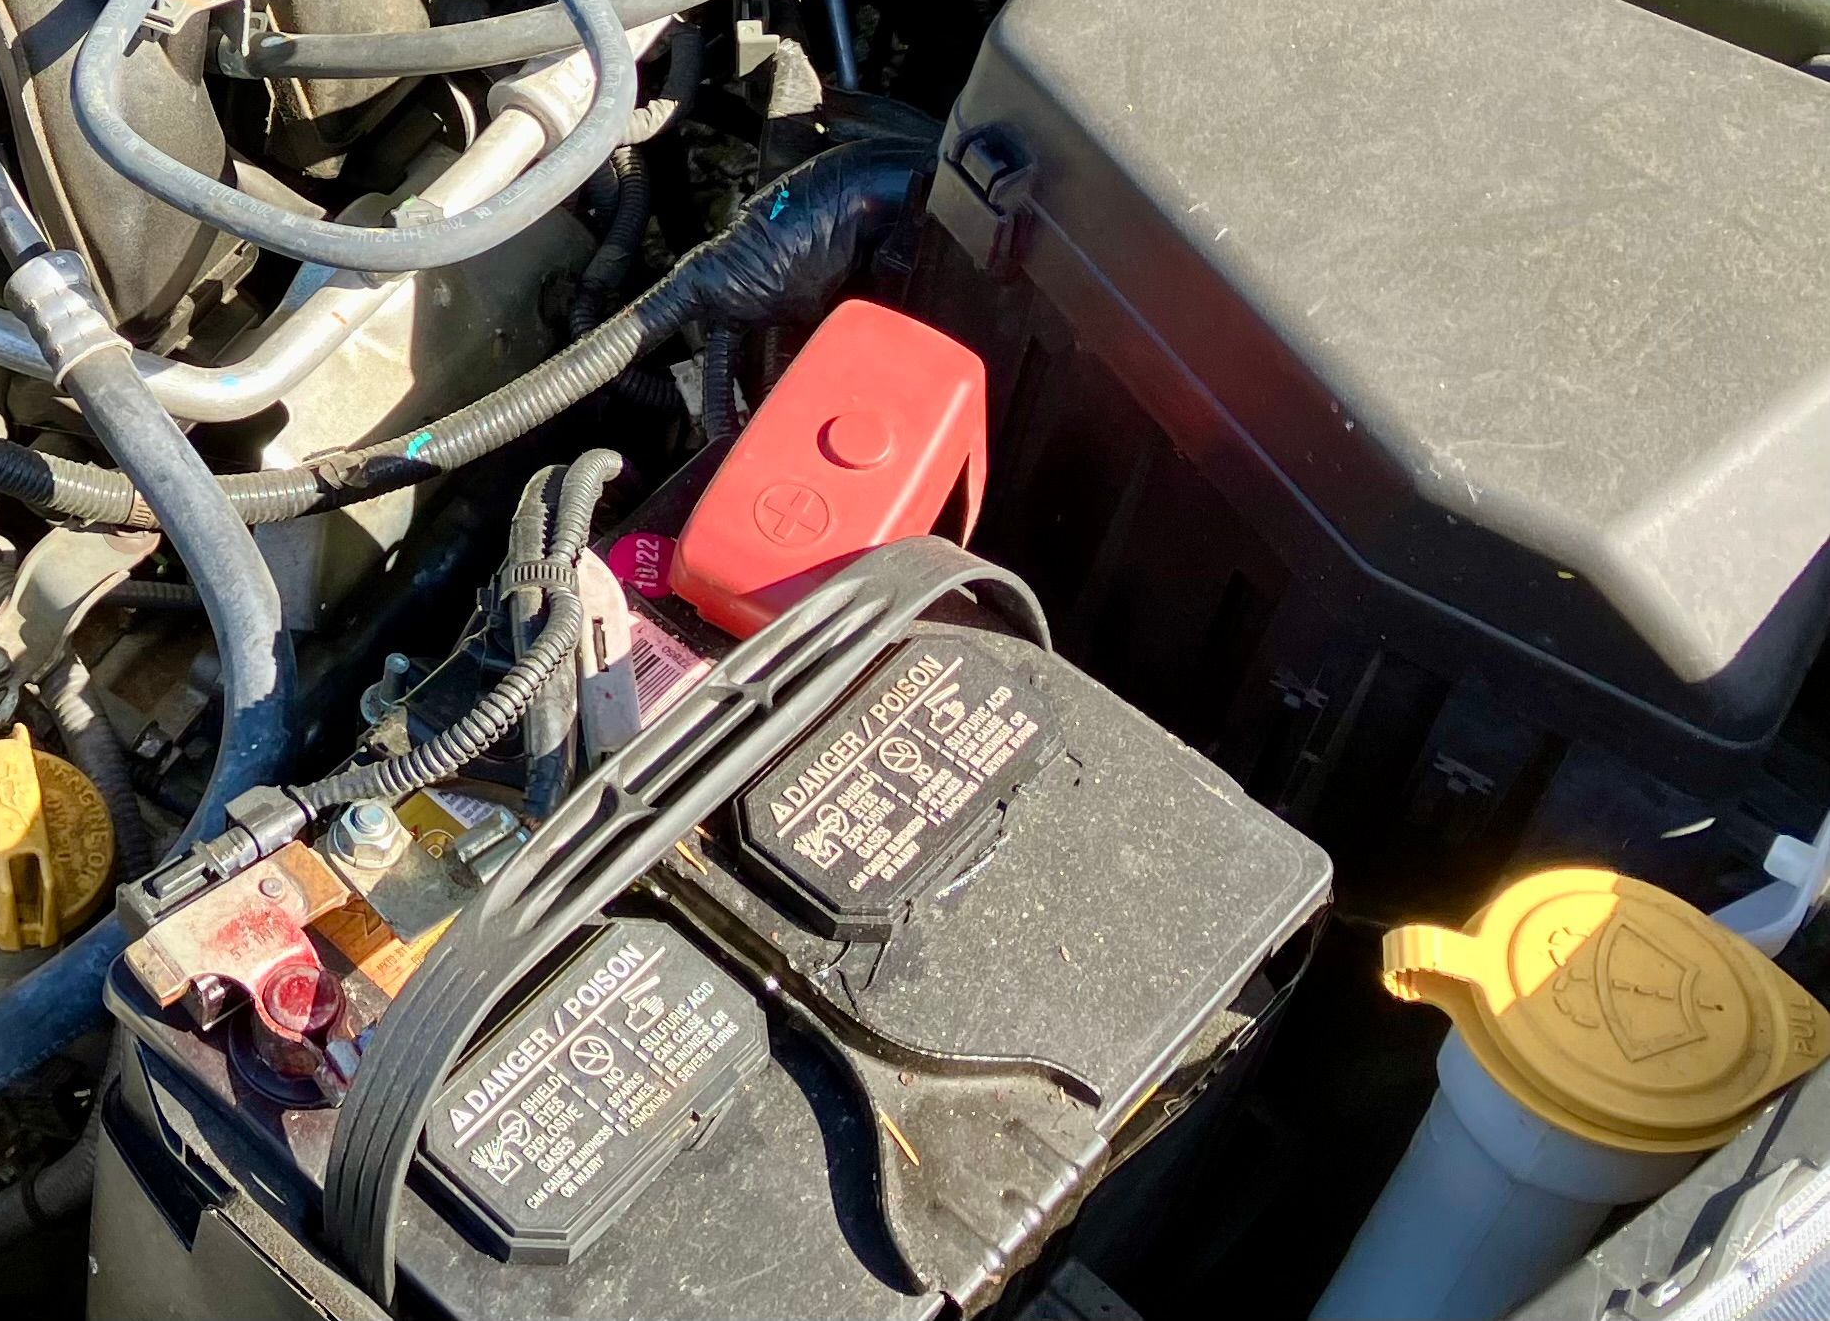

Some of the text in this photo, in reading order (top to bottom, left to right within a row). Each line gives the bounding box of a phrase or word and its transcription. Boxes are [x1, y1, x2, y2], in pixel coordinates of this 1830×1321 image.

[634, 540, 657, 587] 10/22
[782, 727, 865, 810] DANGER
[868, 651, 944, 727] POISON
[943, 684, 1013, 752] SULFURIC ACID
[835, 772, 875, 808] SHIELD
[910, 762, 935, 785] NO
[848, 790, 880, 819] EYES
[939, 780, 980, 817] SMOKING
[841, 797, 897, 850] EXPLOSIVE
[854, 825, 893, 860] GASES
[462, 1024, 558, 1115] DANGER
[561, 941, 646, 1021] POISON
[638, 979, 717, 1051] SULFURIC ACID
[650, 1013, 705, 1062] CAN CAUSE
[661, 1008, 729, 1072] BLINDNESS OR
[674, 1020, 741, 1082] SEVERE BURNS
[518, 1074, 564, 1115] SHIELD
[600, 1066, 626, 1088] NO
[605, 1071, 647, 1108] SPARKS
[532, 1095, 567, 1126] EYES
[616, 1082, 656, 1117] FLAMES
[627, 1087, 674, 1127] SMOKING
[520, 1104, 585, 1162] EXPLOSIVE
[534, 1135, 578, 1174] GASES
[524, 1124, 616, 1209] CAN CAUSE BLINDNESS
[558, 1154, 607, 1199] OR INJURY
